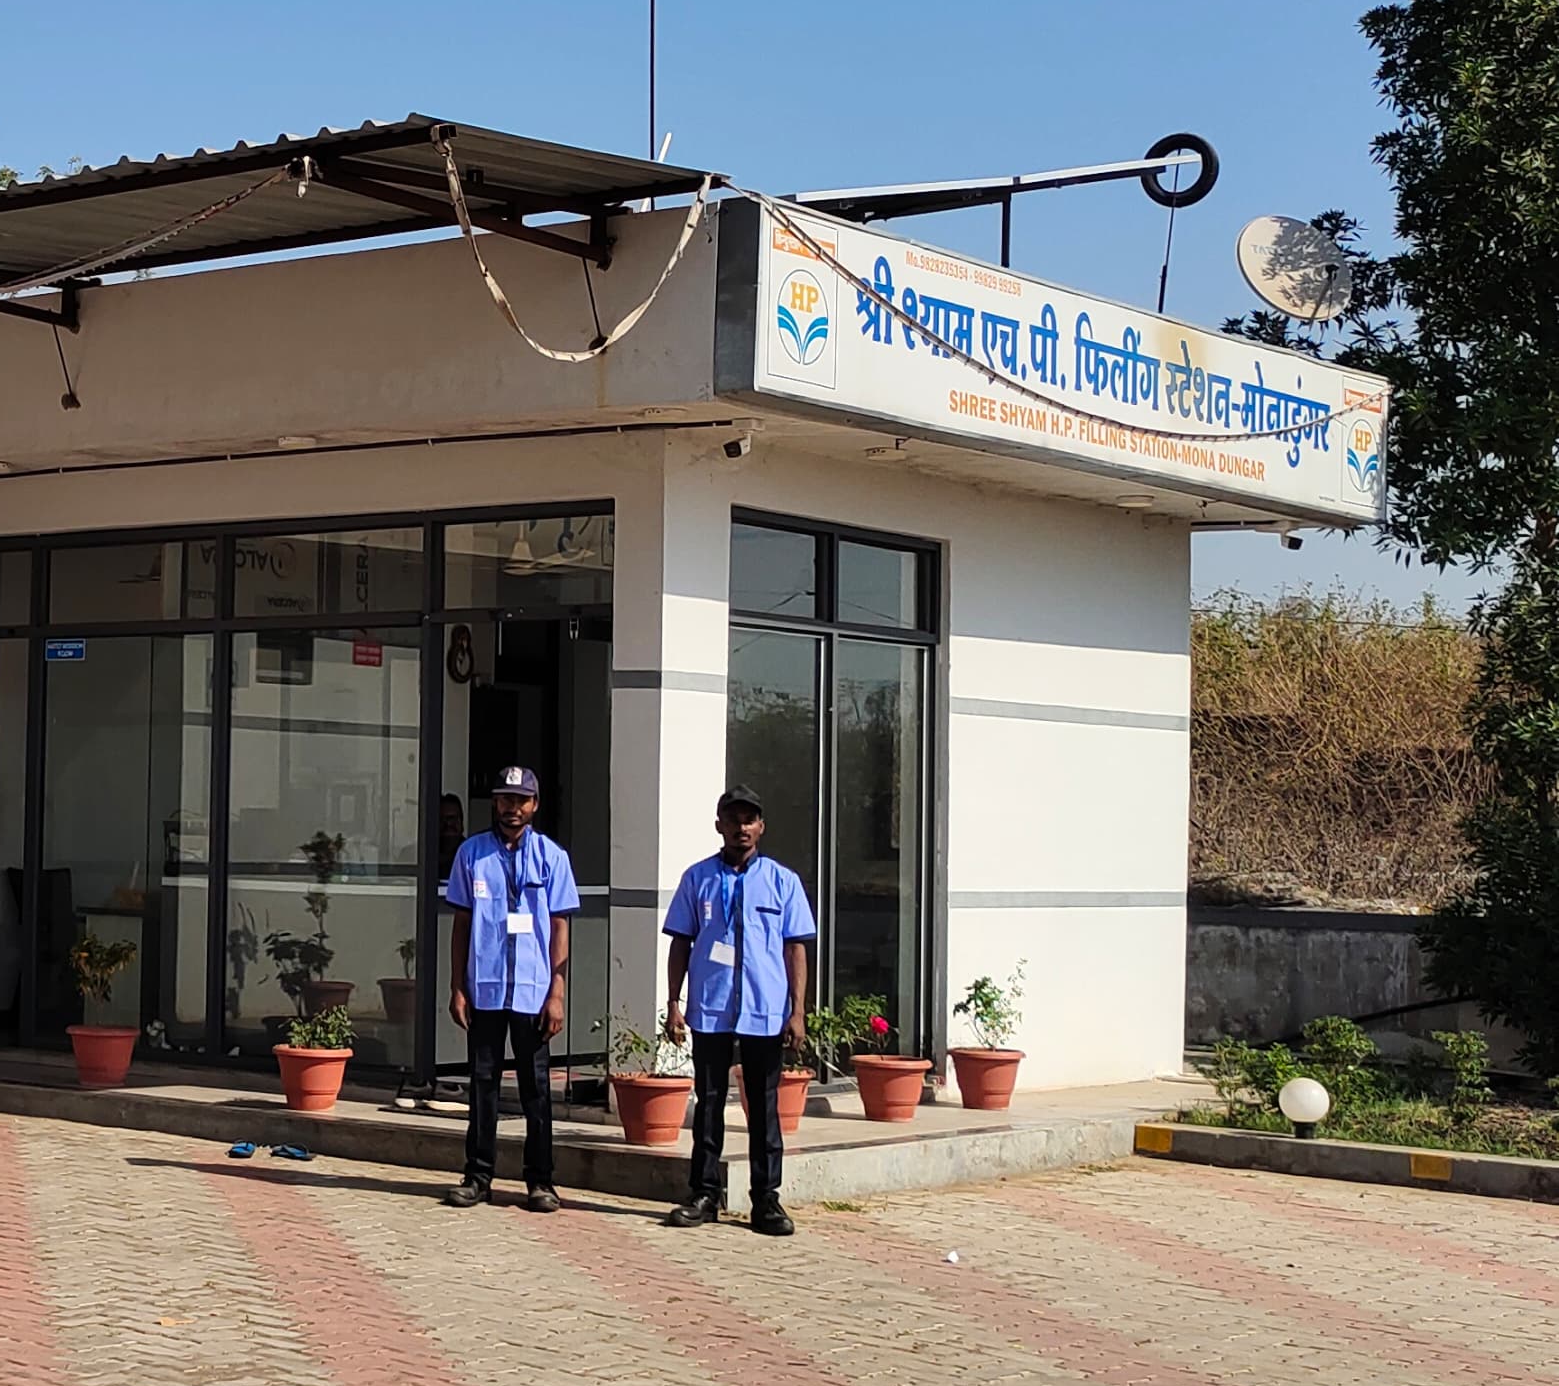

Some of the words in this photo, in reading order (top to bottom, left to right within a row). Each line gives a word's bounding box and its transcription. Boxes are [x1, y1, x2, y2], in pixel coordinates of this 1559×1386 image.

[789, 281, 819, 313] HP
[856, 255, 895, 345] श्री
[901, 287, 975, 359] श्याम
[949, 389, 997, 422] SHREE
[999, 401, 1047, 433] SHYAM
[1051, 412, 1076, 439] H.P.
[1079, 418, 1127, 450] FILLING
[1218, 452, 1266, 482] DUNGAR
[1354, 427, 1373, 453] HP
